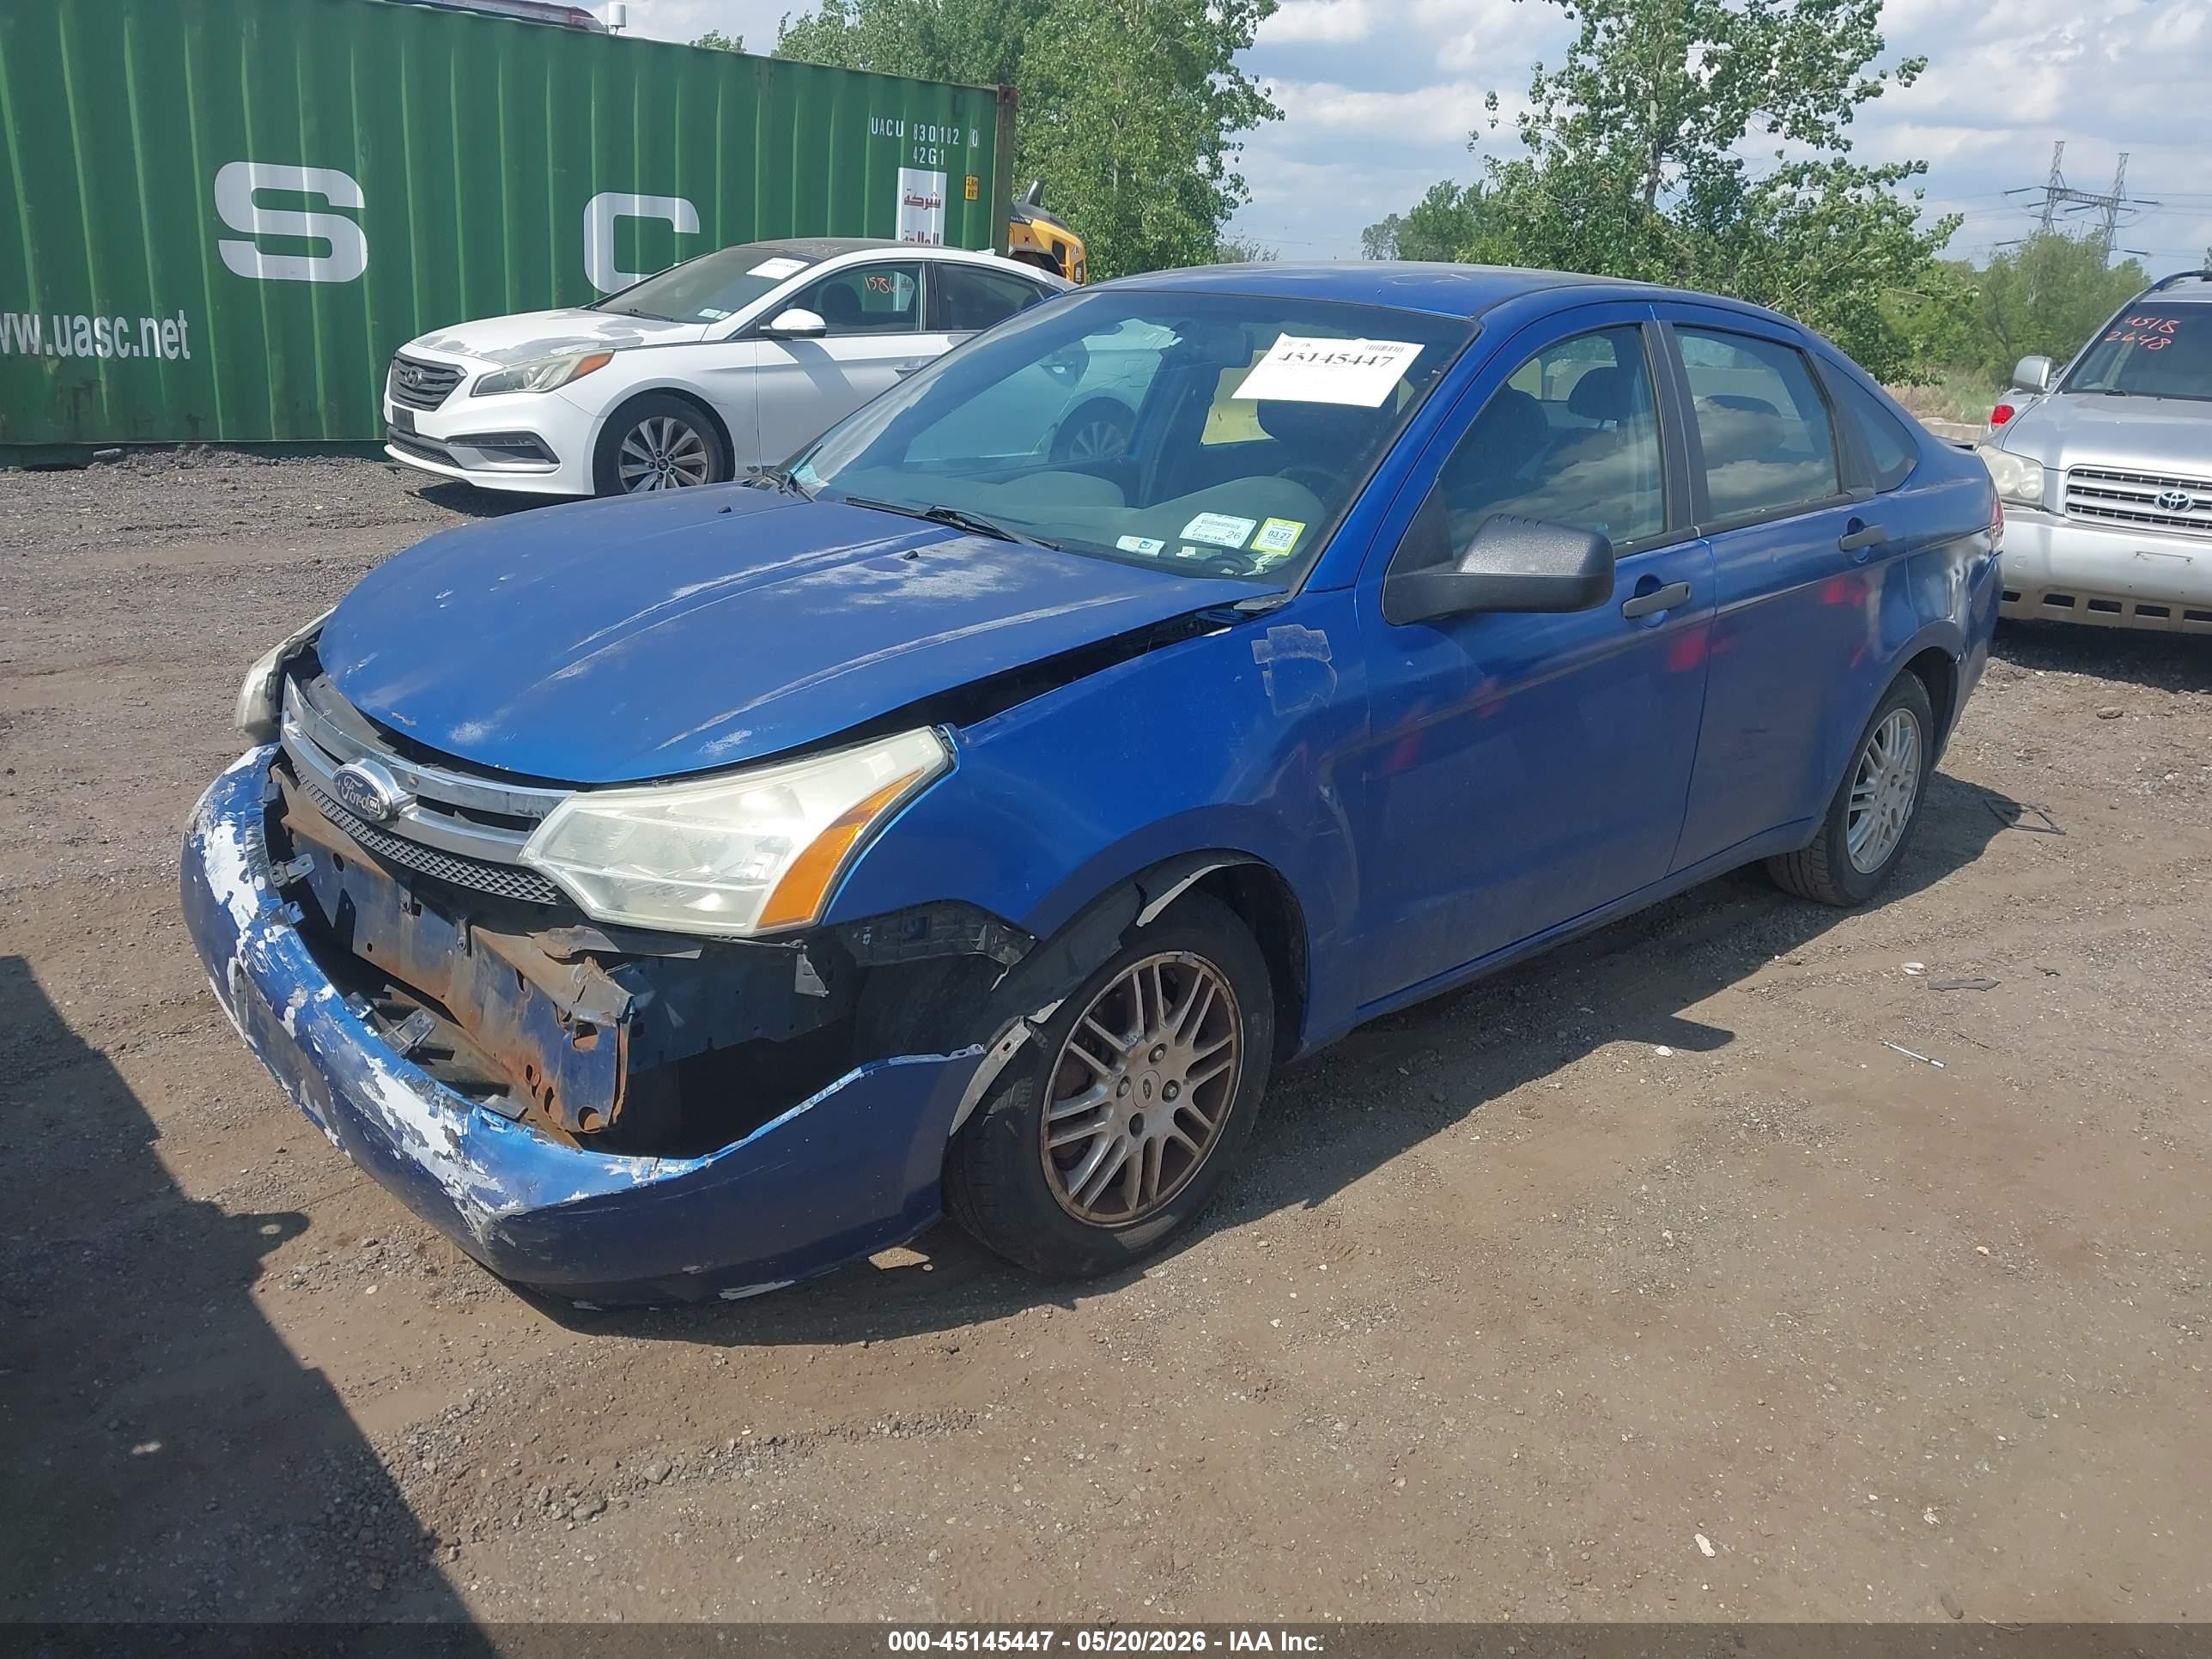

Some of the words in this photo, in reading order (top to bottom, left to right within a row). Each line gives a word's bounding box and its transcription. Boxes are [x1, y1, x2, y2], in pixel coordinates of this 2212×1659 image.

[872, 117, 904, 137] UACU
[914, 124, 959, 145] 830182
[971, 130, 979, 147] 0
[913, 146, 945, 166] 42G1
[904, 188, 941, 210] شركة
[215, 161, 368, 282] S
[584, 192, 700, 294] C
[2124, 316, 2181, 334] 4518
[2105, 331, 2172, 350] 2648
[1225, 530, 1241, 540] 26
[1268, 530, 1279, 538] 03
[1279, 532, 1292, 540] 27
[341, 775, 371, 810] Ford
